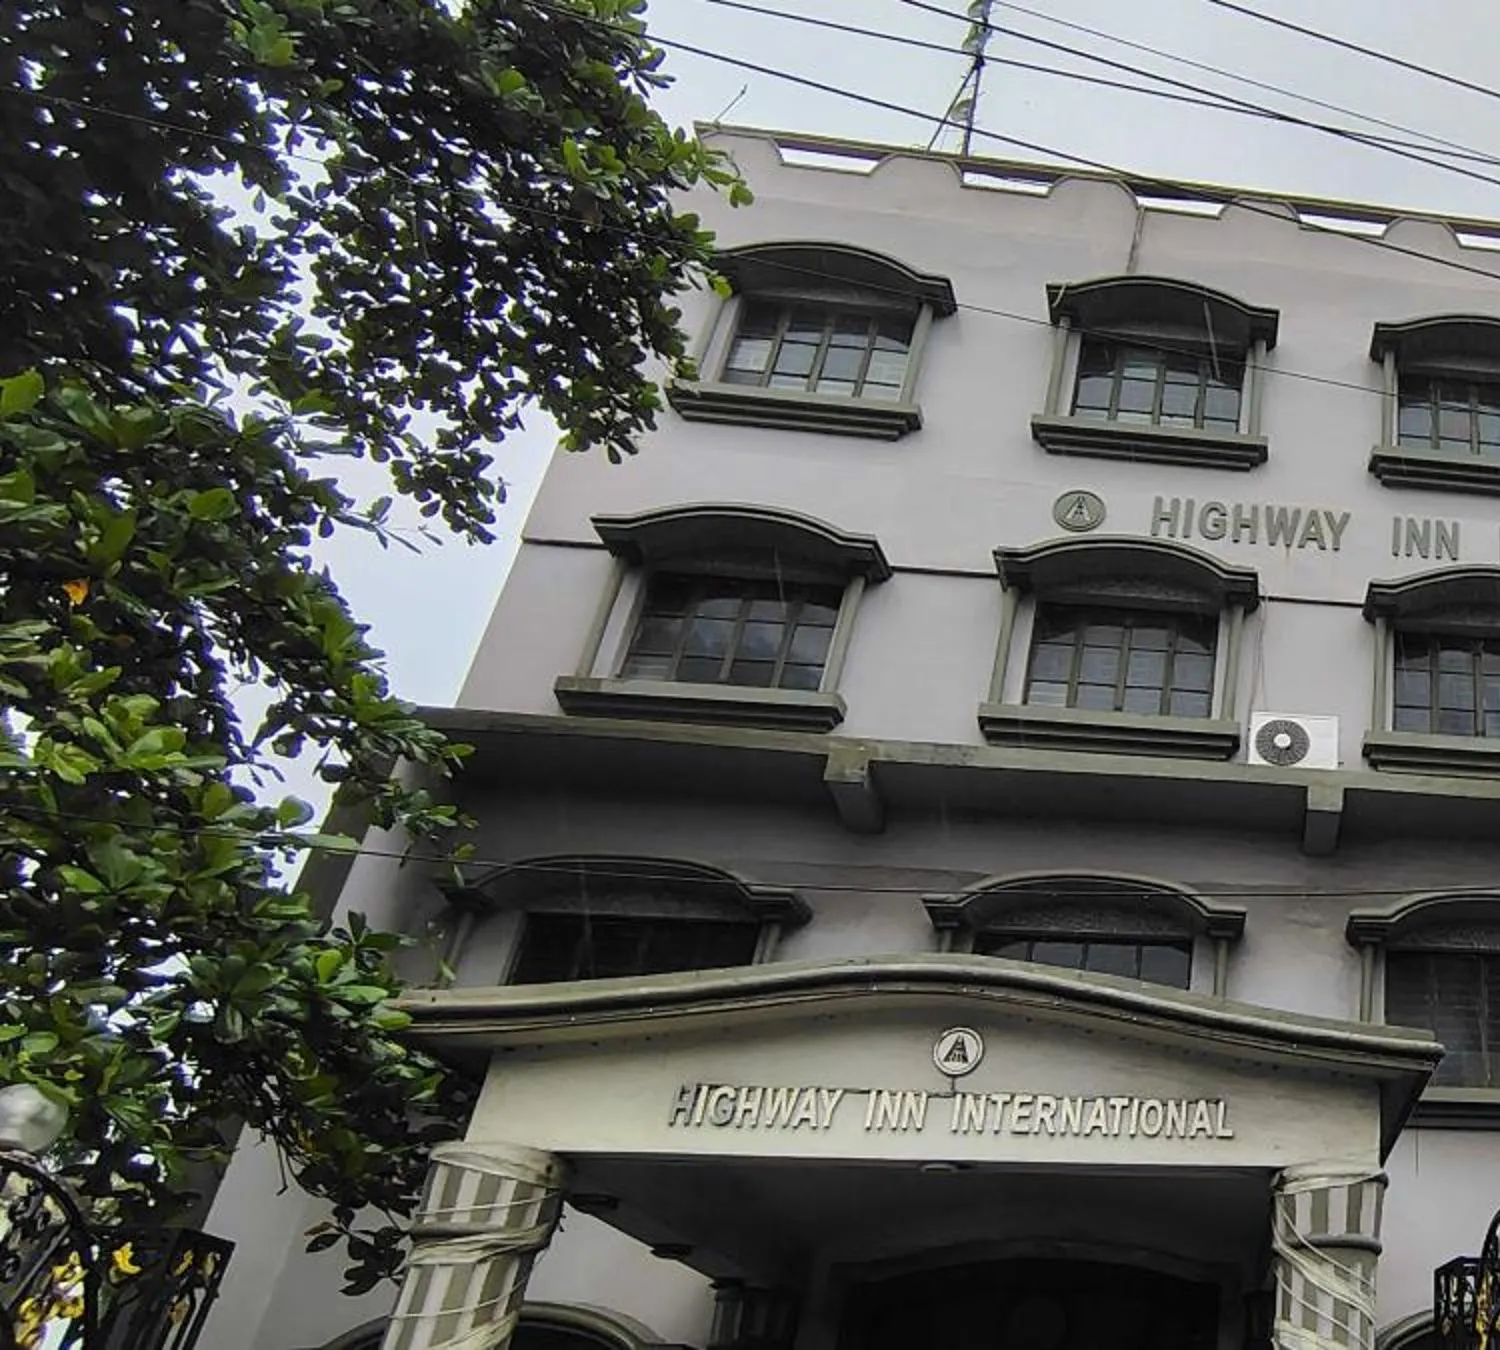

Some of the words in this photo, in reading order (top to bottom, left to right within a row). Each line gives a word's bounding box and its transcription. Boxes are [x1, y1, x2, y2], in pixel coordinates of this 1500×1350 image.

[1150, 496, 1351, 552] HIGHWAY
[1392, 516, 1459, 560] INN
[669, 1084, 844, 1129] HIGHWAY
[865, 1088, 929, 1132] INN
[951, 1092, 1235, 1140] INTERNATIONAL
